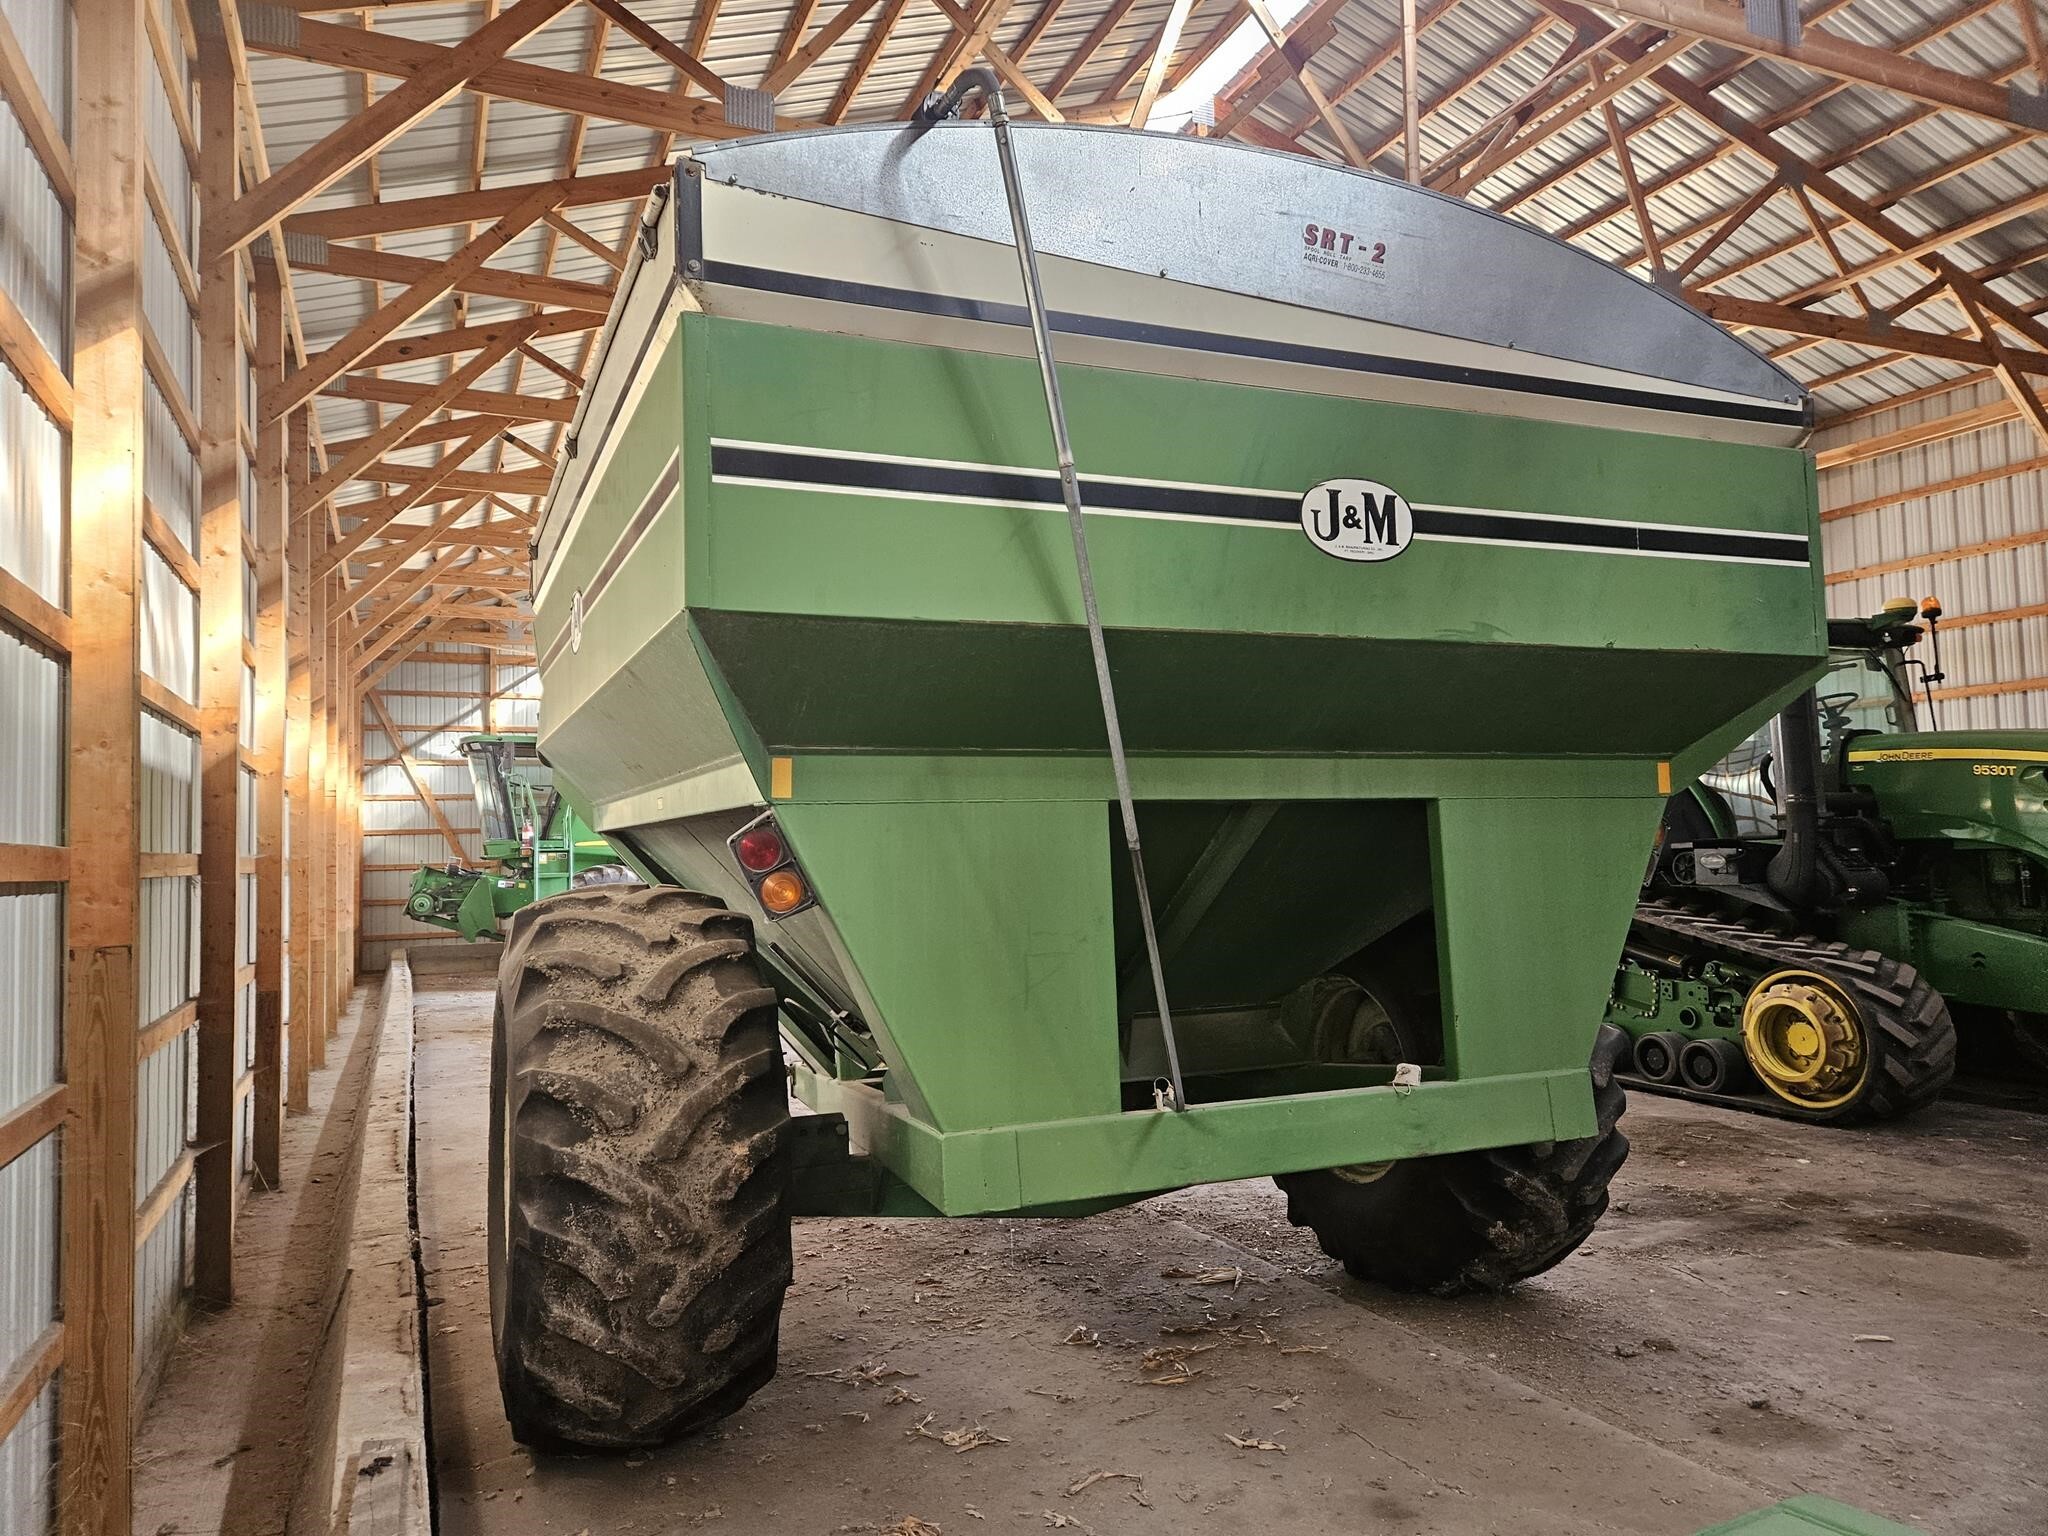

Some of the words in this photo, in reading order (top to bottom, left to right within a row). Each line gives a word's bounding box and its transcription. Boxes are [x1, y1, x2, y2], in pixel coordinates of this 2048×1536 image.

[1303, 252, 1339, 268] AGRI-COVER
[1310, 488, 1400, 546] J&M
[1879, 752, 1901, 761] JOHN
[1902, 751, 1934, 760] DEERE
[1972, 764, 2018, 777] 9530T
